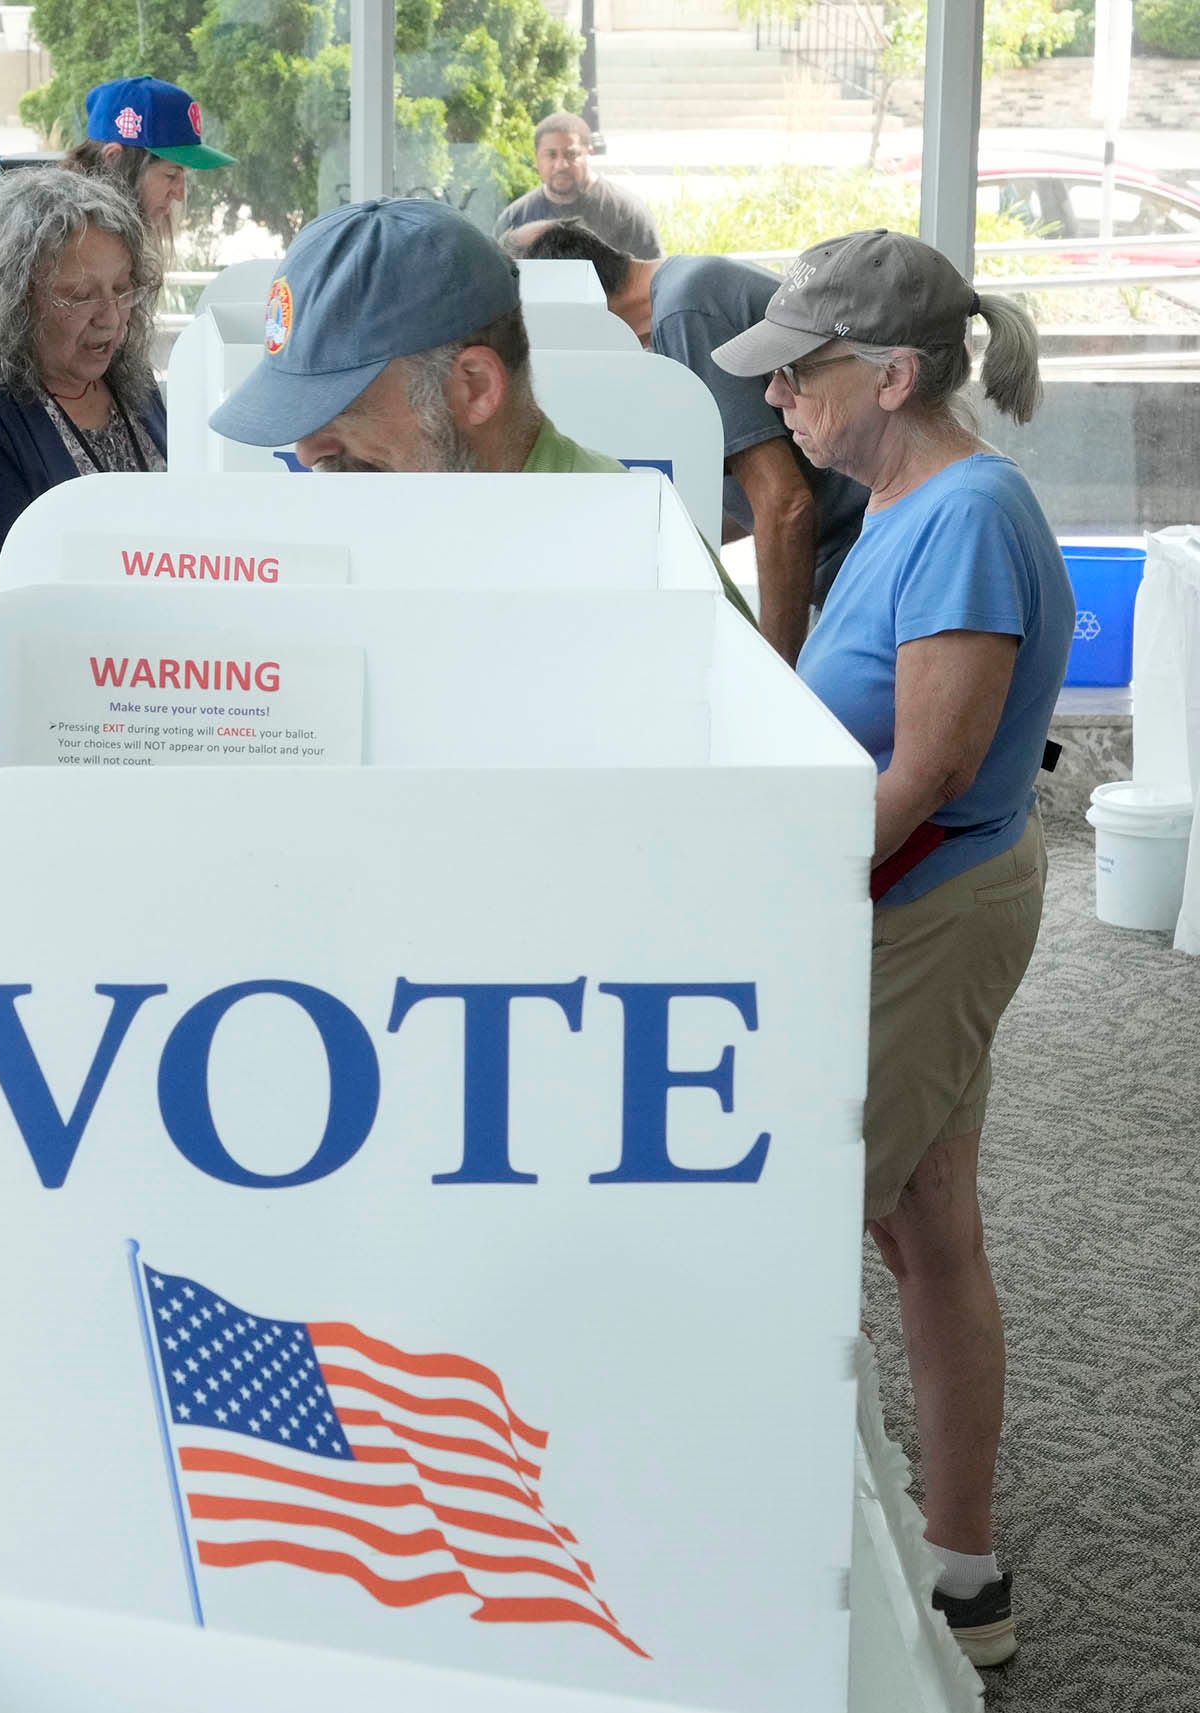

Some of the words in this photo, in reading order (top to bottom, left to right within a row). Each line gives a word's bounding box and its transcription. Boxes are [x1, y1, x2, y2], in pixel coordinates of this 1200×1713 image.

[121, 550, 280, 583] WARNING
[89, 656, 281, 692] WARNING
[109, 701, 141, 713] Make
[144, 704, 168, 714] sure
[171, 705, 197, 716] your
[200, 705, 225, 716] vote
[228, 706, 270, 717] counts!
[58, 721, 100, 734] Pressing
[102, 723, 125, 733] EXIT
[127, 724, 160, 736] during
[163, 726, 194, 737] voting
[196, 726, 214, 736] will
[216, 727, 257, 737] CANCEL
[259, 730, 282, 739] your
[285, 729, 317, 739] ballot.
[58, 738, 81, 748] Your
[84, 738, 121, 750] choices
[124, 740, 141, 750] will
[144, 741, 166, 751] NOT
[168, 742, 204, 753] appear
[206, 744, 220, 752] on
[223, 744, 246, 755] your
[248, 743, 278, 755] ballot
[280, 745, 299, 755] and
[301, 747, 325, 758] your
[57, 754, 81, 764] vote
[83, 754, 101, 765] will
[103, 756, 120, 766] not
